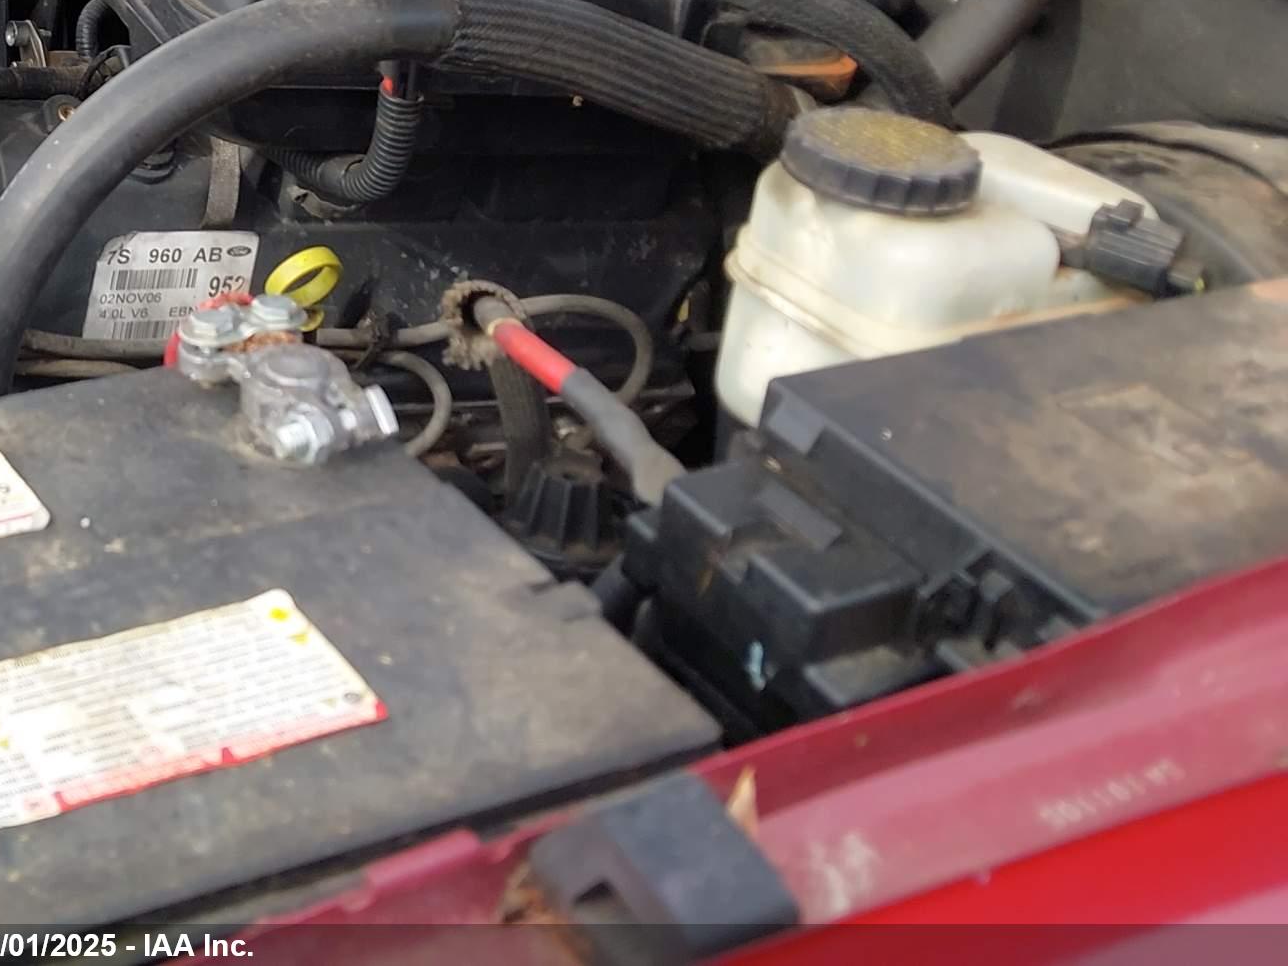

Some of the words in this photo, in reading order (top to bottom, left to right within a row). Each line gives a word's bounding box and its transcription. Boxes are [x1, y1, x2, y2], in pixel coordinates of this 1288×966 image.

[148, 248, 182, 264] 960
[193, 246, 223, 263] AB
[99, 292, 162, 305] 02NOV06
[99, 308, 126, 319] 40L
[131, 307, 149, 318] V6
